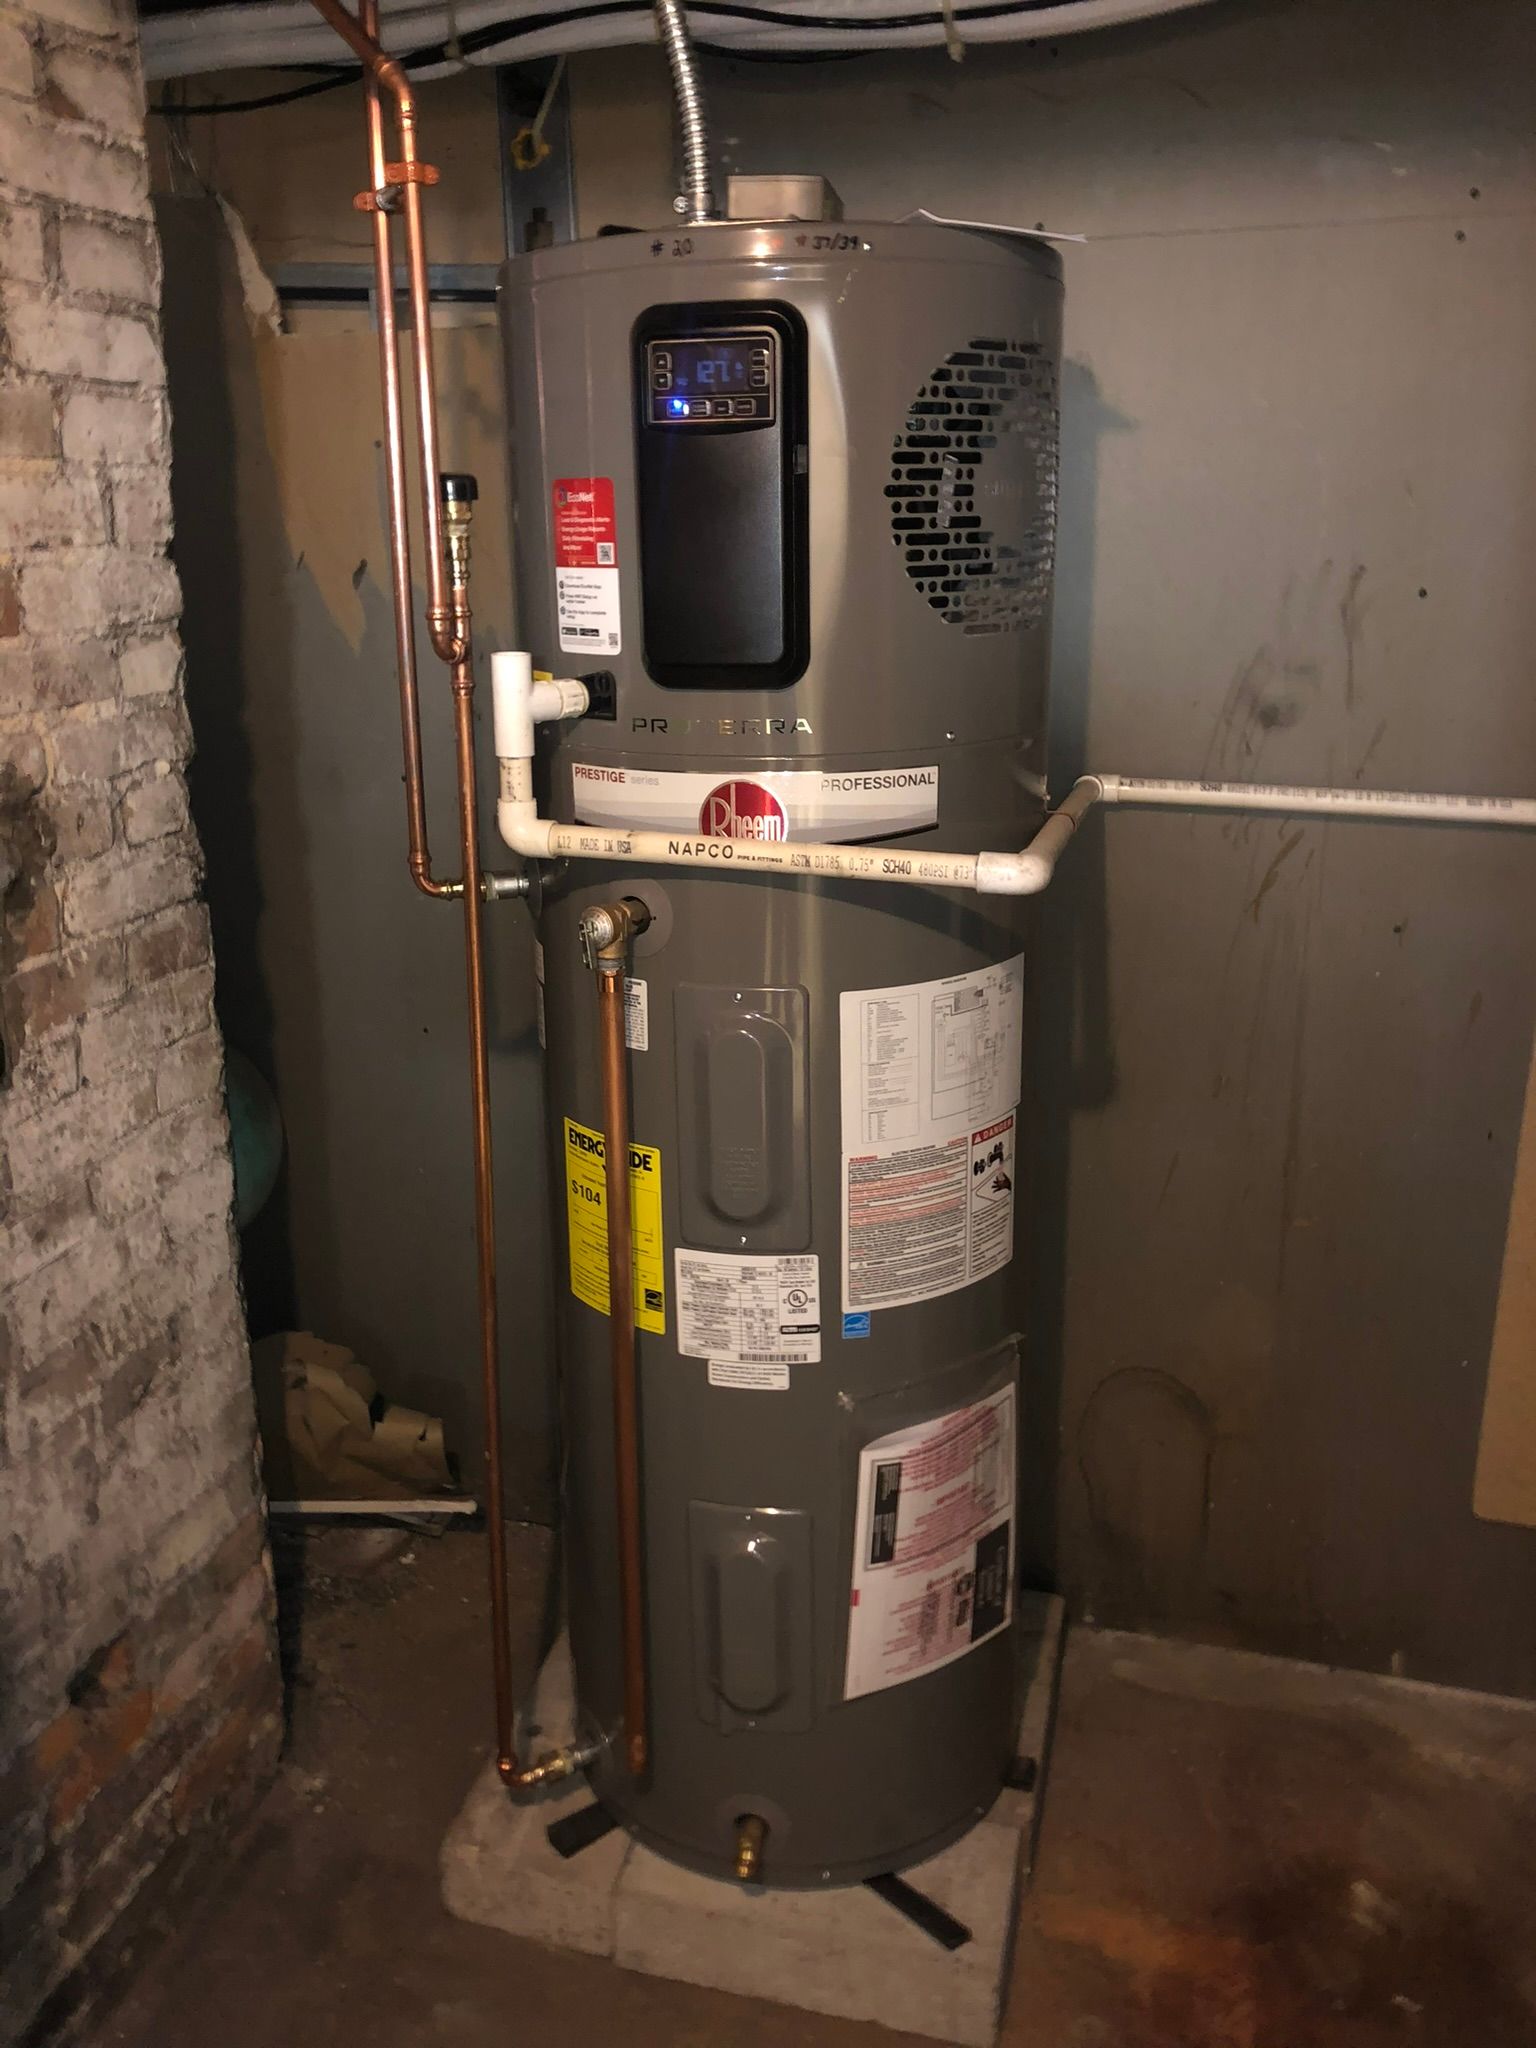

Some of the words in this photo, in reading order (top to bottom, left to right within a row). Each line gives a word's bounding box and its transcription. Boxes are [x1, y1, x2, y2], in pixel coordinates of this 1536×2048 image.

[575, 766, 626, 784] PRESTIGE
[631, 776, 660, 786] series
[821, 772, 935, 792] PROFESSIONAL
[709, 783, 782, 842] Rheem
[580, 838, 600, 851] MADE
[604, 840, 614, 852] IN
[617, 841, 633, 854] USA
[668, 841, 734, 859] NAPCO
[790, 854, 811, 868] ASTM
[882, 859, 912, 875] SCH40
